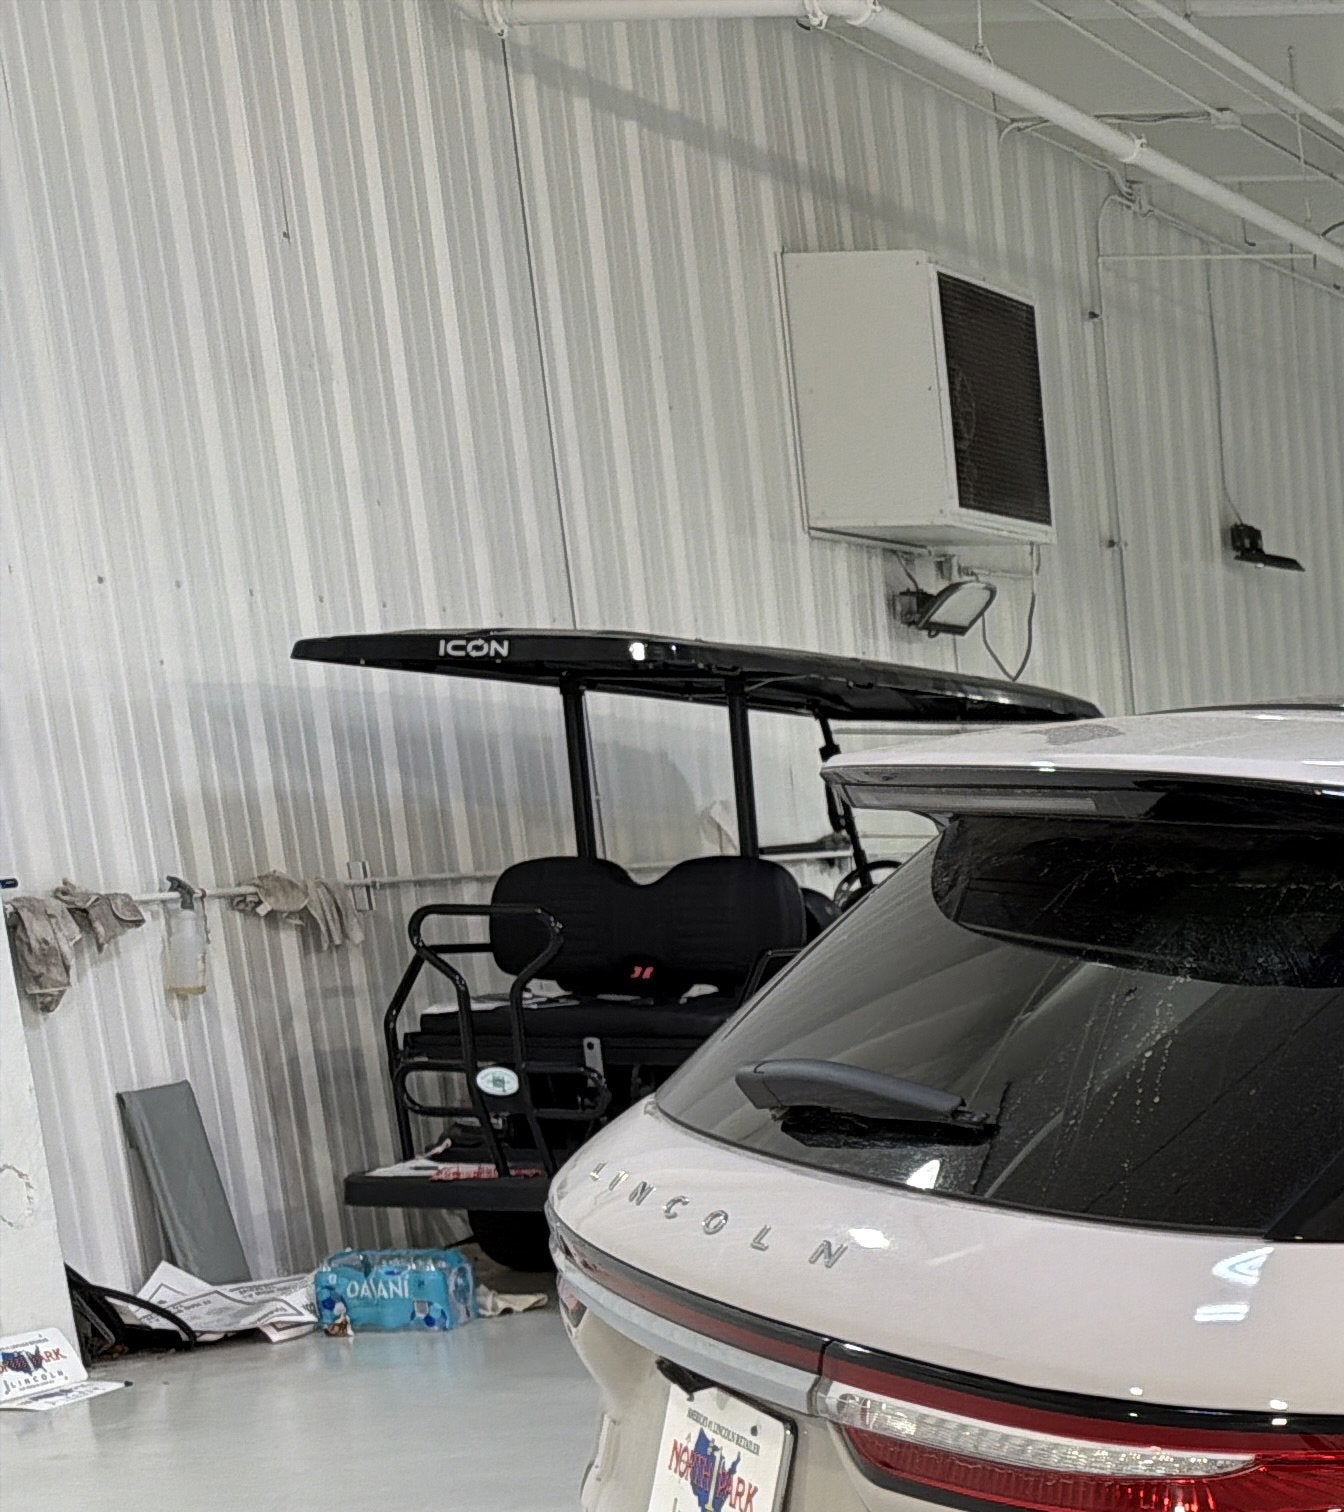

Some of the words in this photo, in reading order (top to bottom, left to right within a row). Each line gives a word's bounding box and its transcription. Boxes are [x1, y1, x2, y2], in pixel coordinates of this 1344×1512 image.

[438, 638, 509, 658] ICON
[589, 1161, 849, 1269] LINCOLN
[668, 1438, 711, 1493] NORTH
